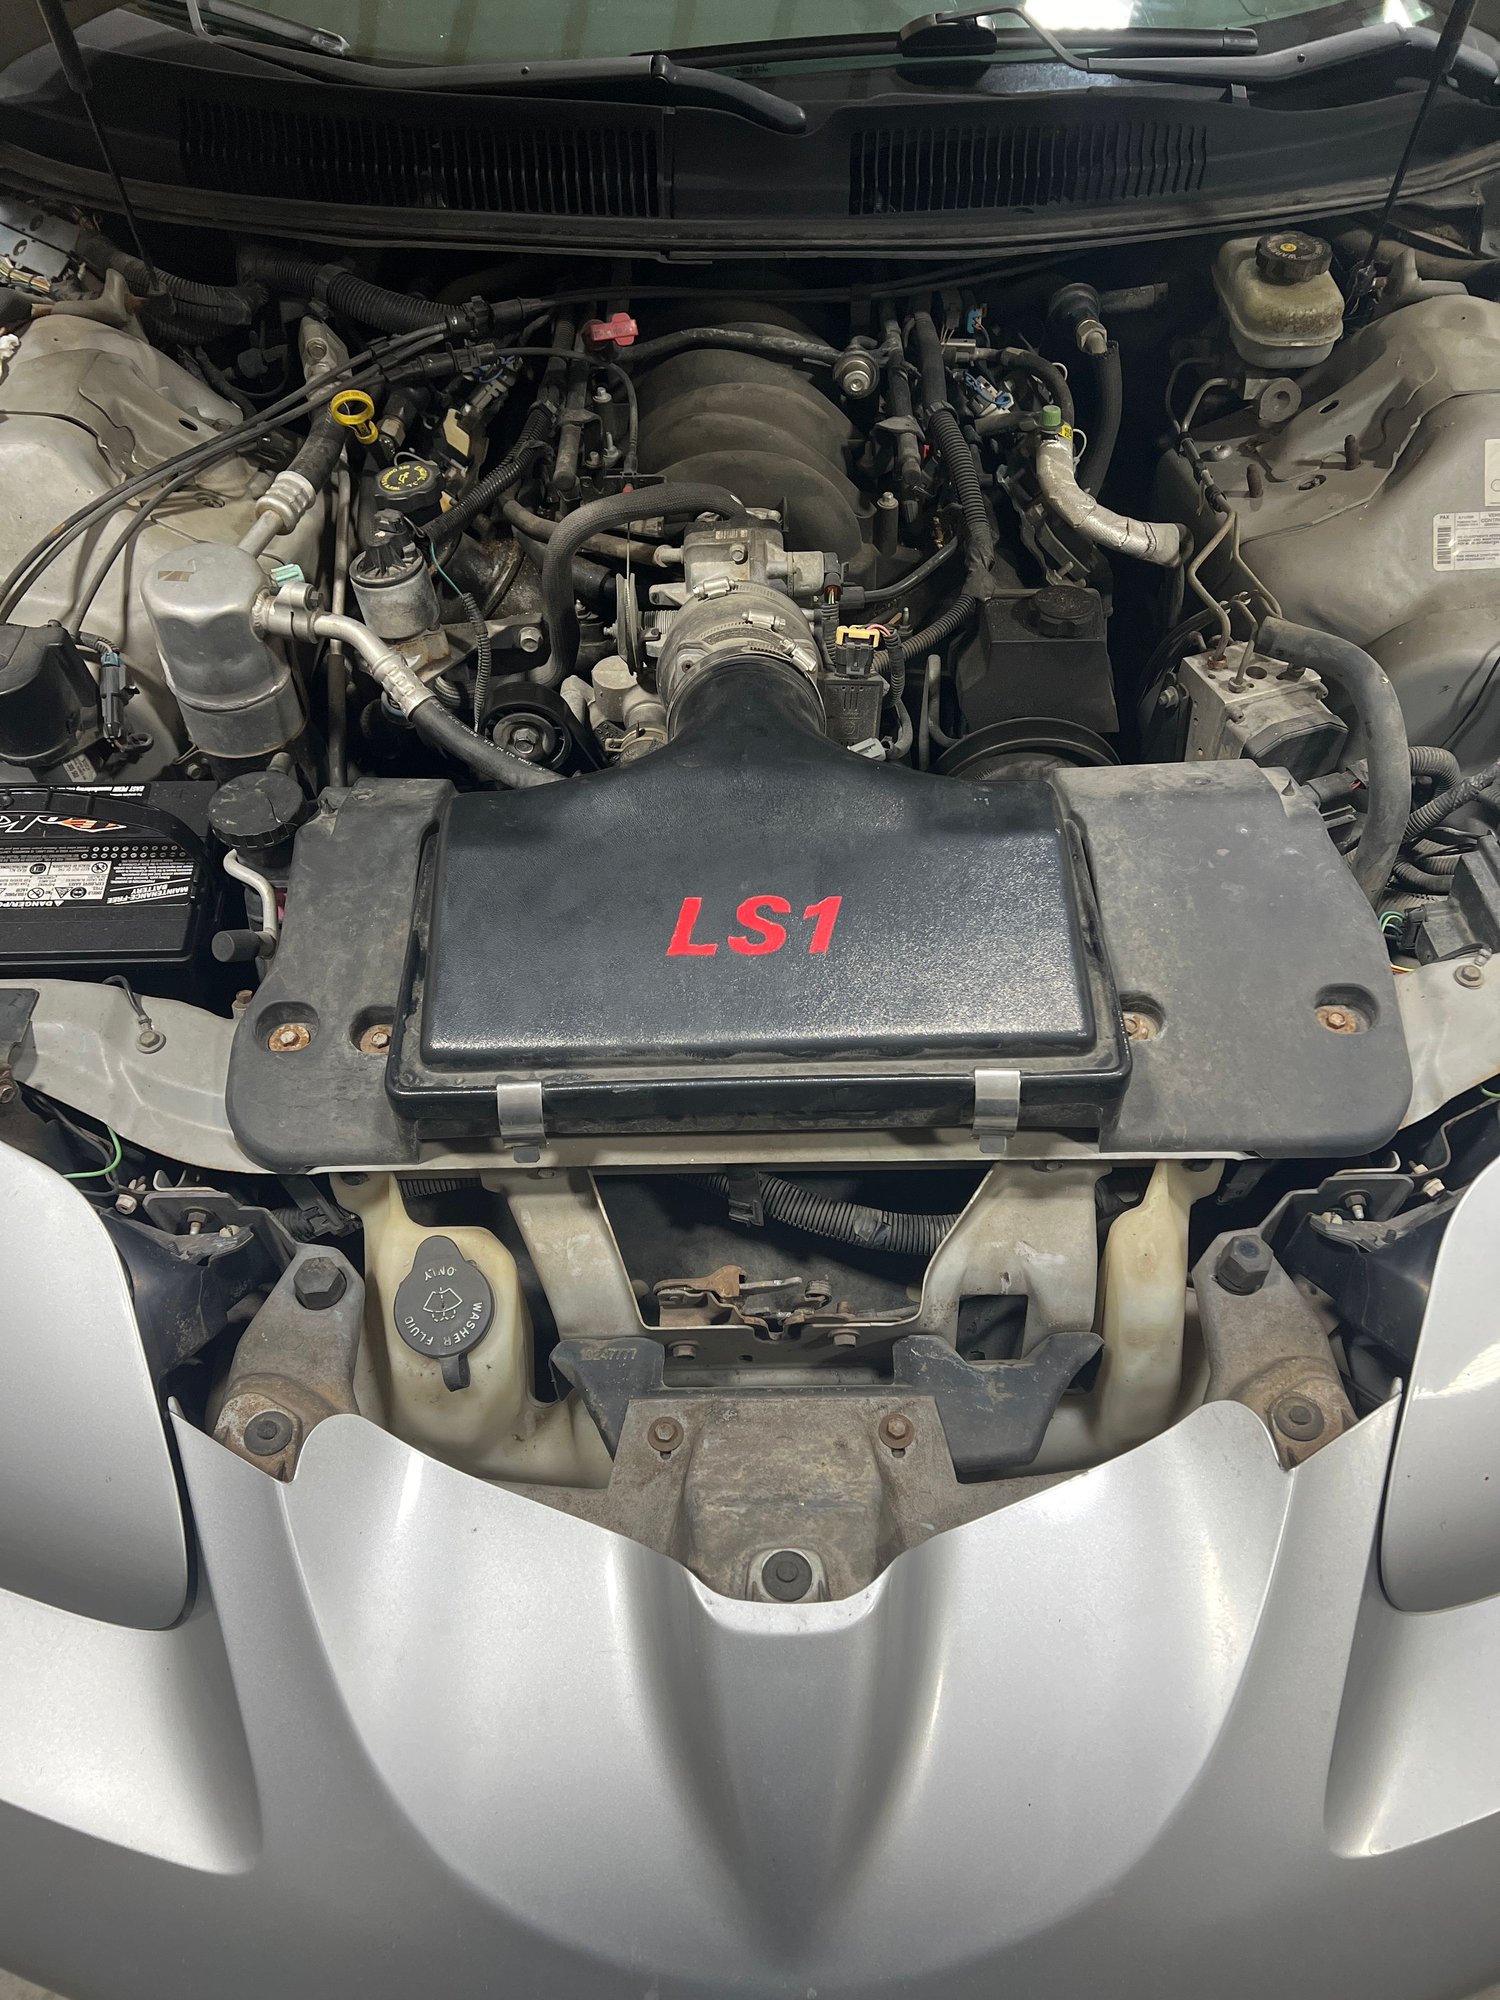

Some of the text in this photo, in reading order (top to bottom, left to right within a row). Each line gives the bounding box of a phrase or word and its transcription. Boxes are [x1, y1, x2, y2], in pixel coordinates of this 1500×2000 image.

[106, 886, 189, 904] MAINTENANCE-FREE
[130, 884, 168, 895] BATTERY
[666, 895, 843, 956] LS1
[404, 1265, 483, 1346] WASHER FLUID ONLY
